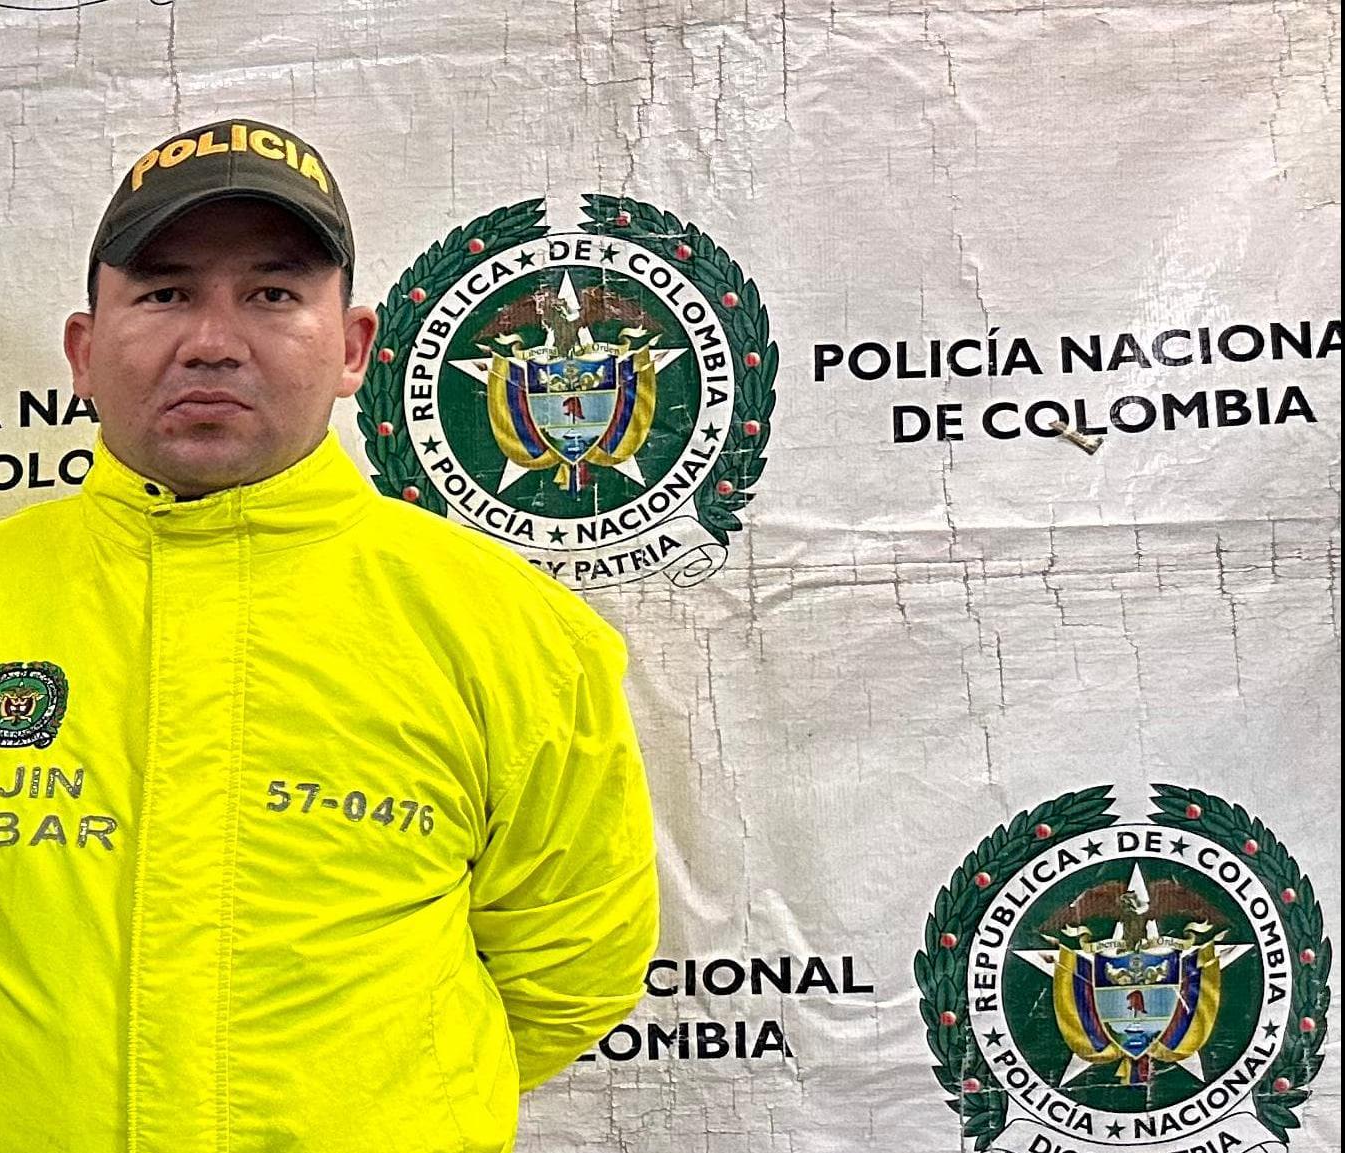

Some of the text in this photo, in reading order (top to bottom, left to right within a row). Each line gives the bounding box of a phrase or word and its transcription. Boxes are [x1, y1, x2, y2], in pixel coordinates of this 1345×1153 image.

[131, 125, 329, 194] POLICIA
[413, 240, 728, 422] REPÚBLICA DE COLOMBIA
[813, 320, 1341, 382] POLICÍA NACIONA
[893, 386, 1318, 443] DE COLOMBIA
[430, 445, 716, 544] POLICÍA NACIONAL
[575, 534, 682, 583] PATRIA
[265, 780, 435, 837] 57-0476
[974, 831, 1287, 1012] REPÚBLICA DE COLOMBIA
[646, 956, 874, 997] CIONAL
[581, 1020, 794, 1062] OMBIA
[993, 1040, 1276, 1139] POLICÍA NACIONAL
